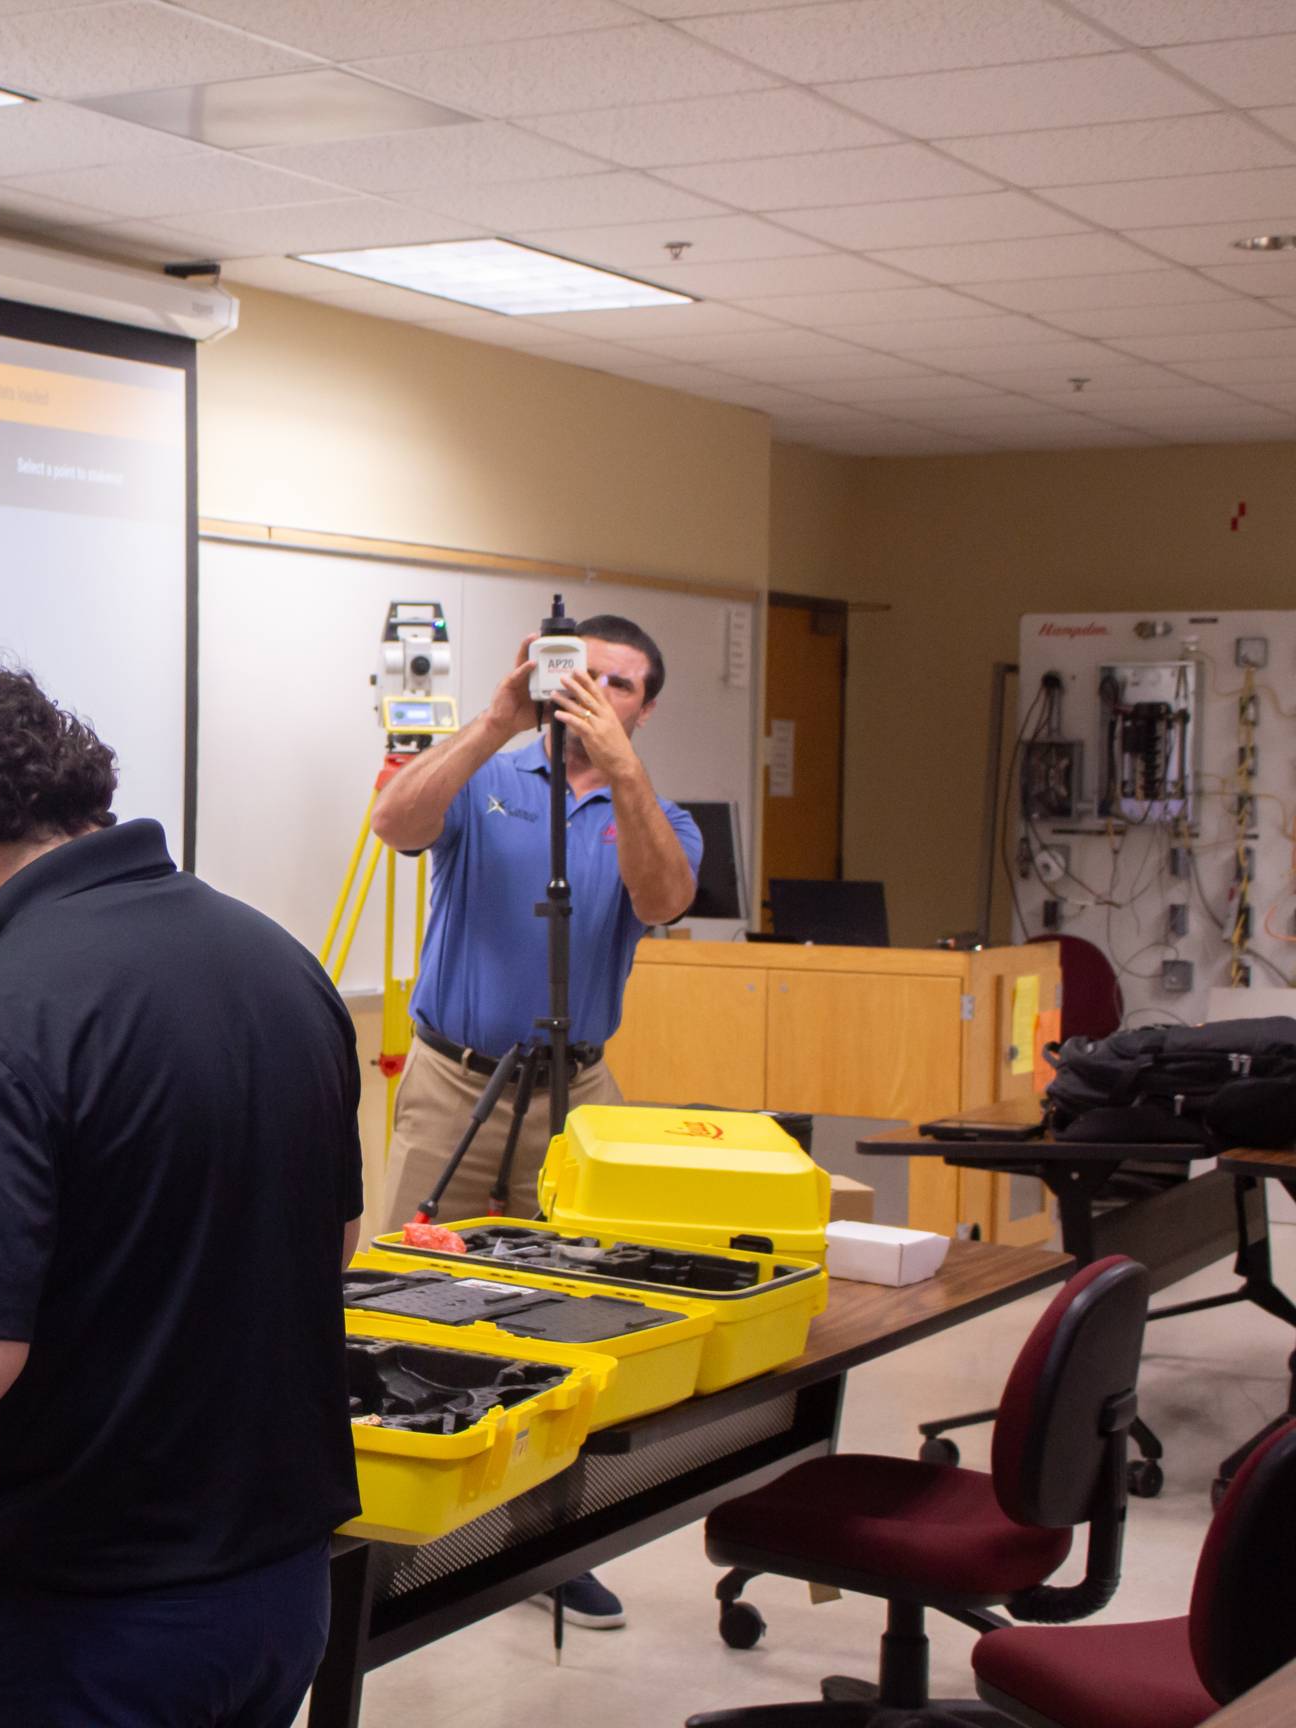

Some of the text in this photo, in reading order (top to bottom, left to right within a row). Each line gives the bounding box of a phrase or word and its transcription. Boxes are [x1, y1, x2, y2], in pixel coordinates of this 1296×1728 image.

[17, 457, 44, 475] Select
[54, 464, 75, 480] point
[548, 659, 574, 668] AP20
